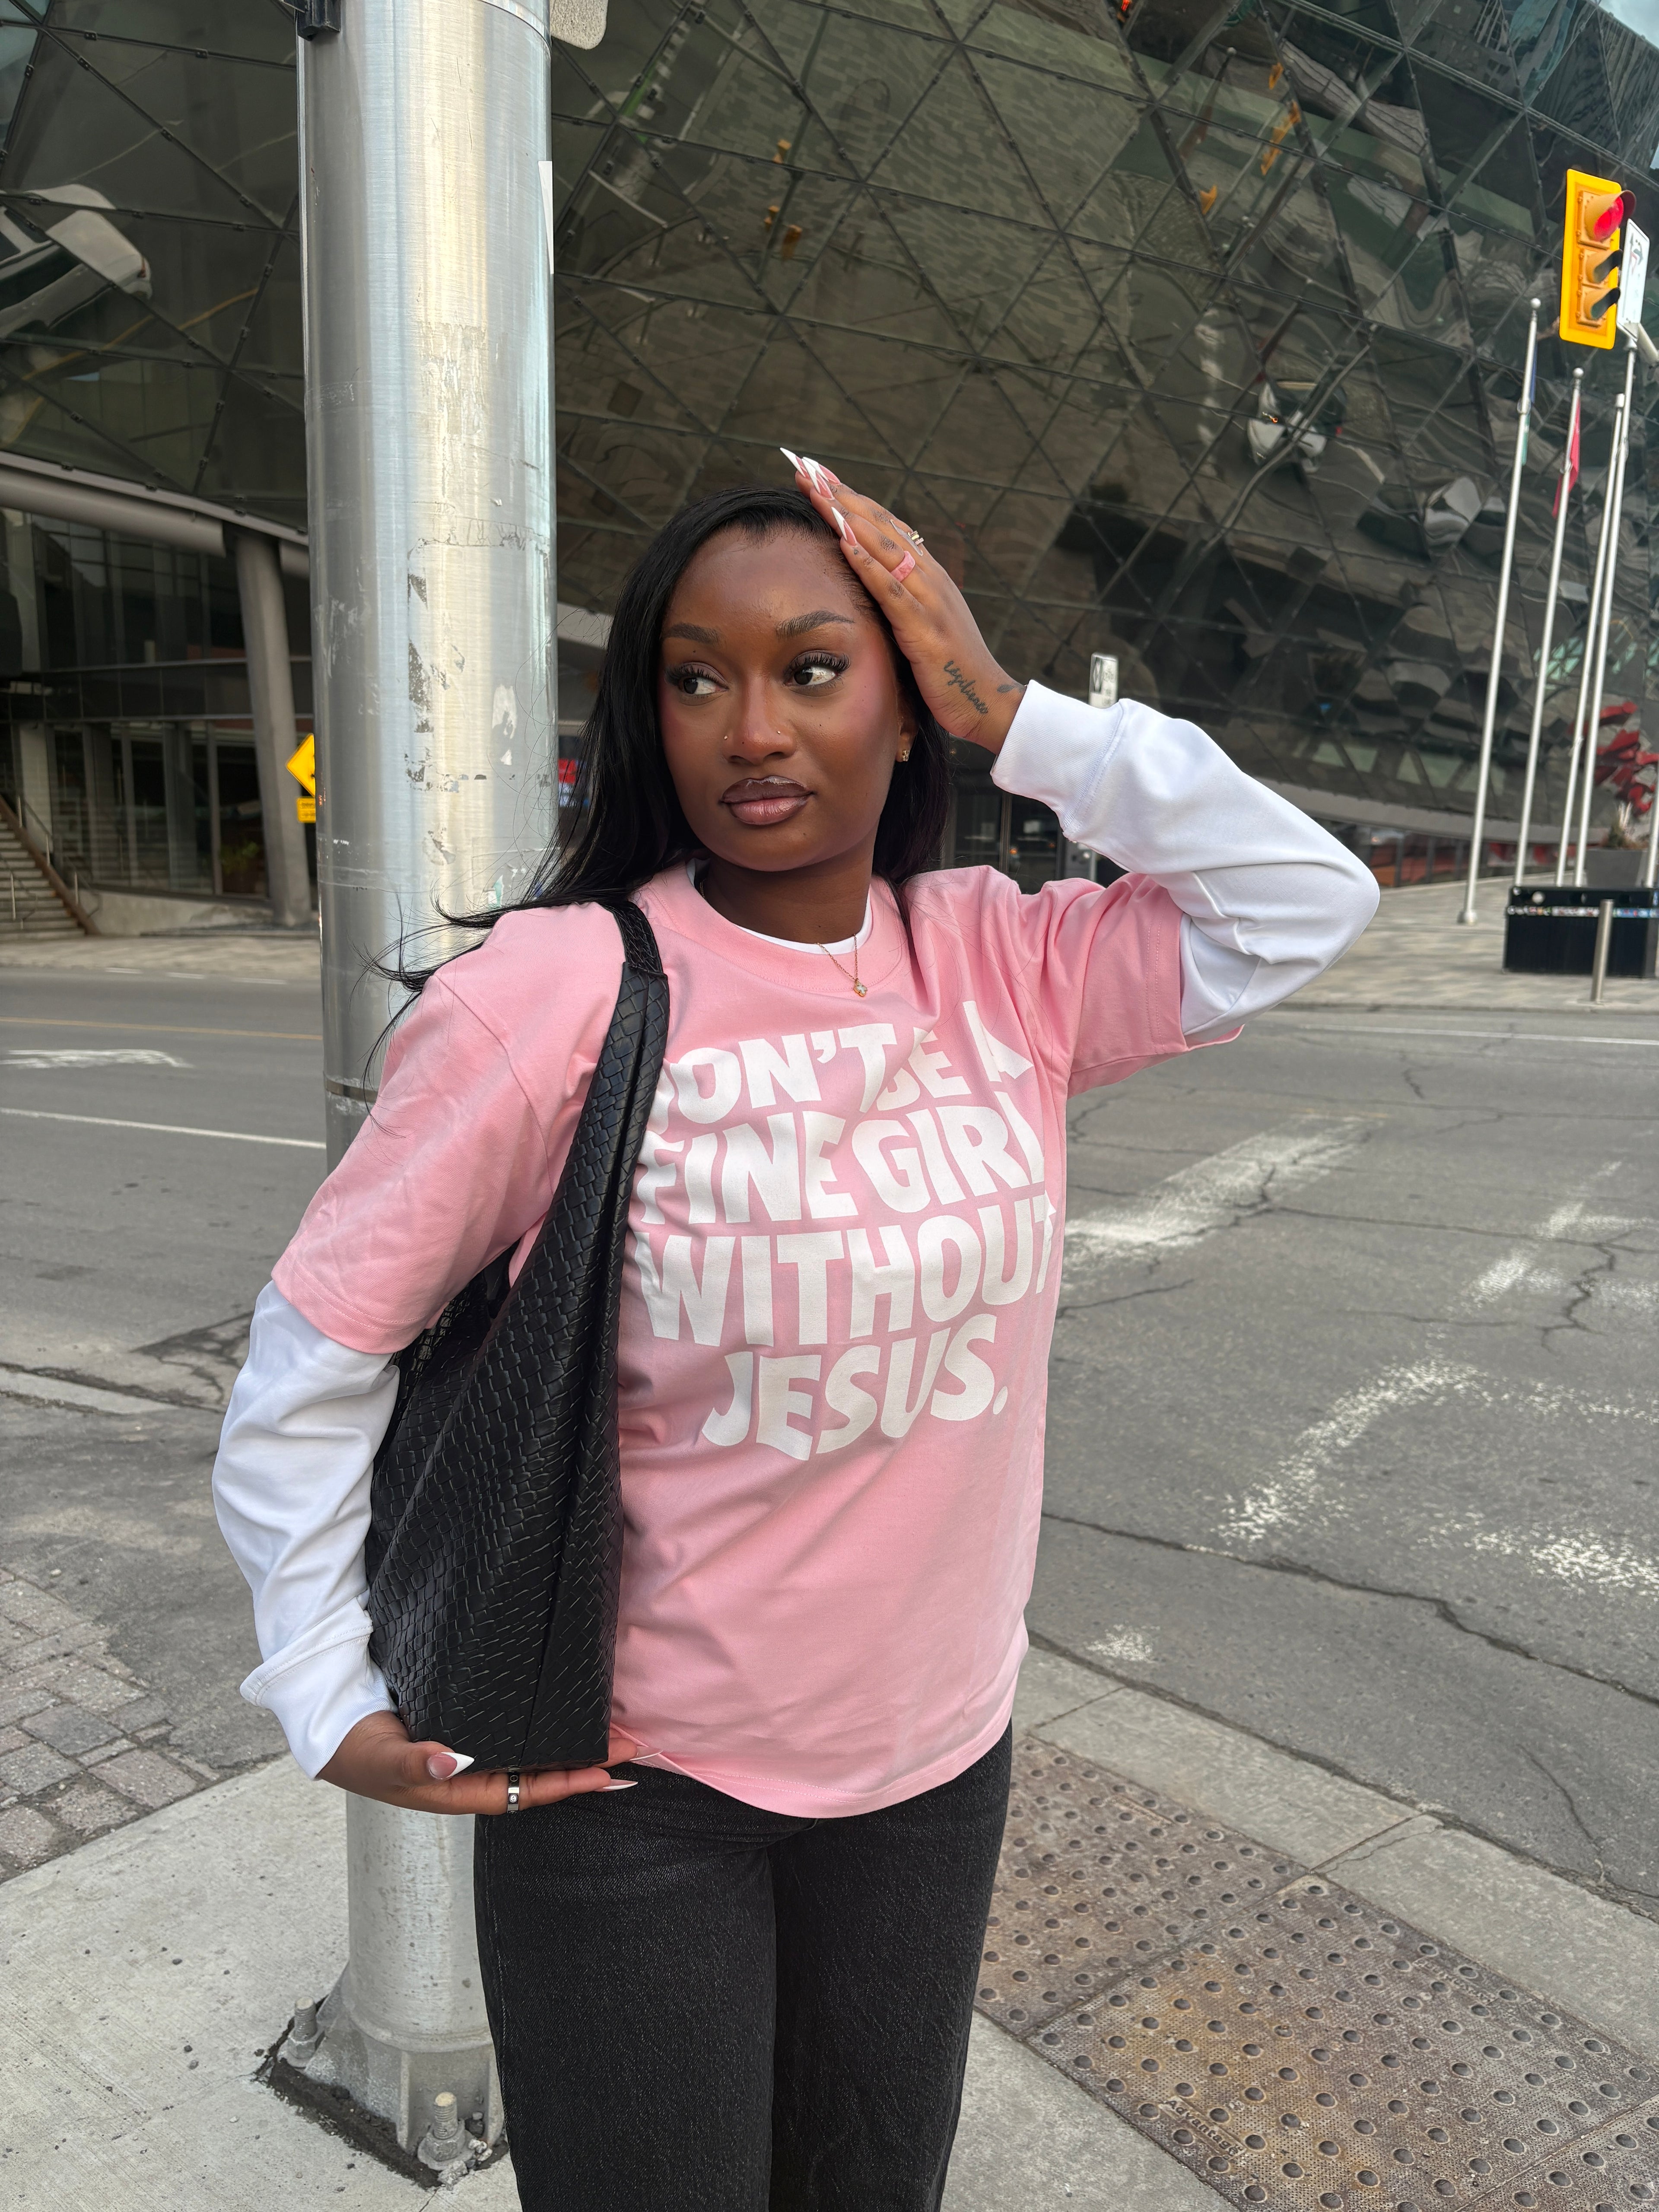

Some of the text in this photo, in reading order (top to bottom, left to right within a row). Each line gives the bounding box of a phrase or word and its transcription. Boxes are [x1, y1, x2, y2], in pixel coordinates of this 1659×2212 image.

[963, 1000, 1034, 1082] A
[637, 1110, 858, 1224] FINE
[635, 1189, 1057, 1347] WITHOUT
[702, 1313, 1007, 1461] JESUS.
